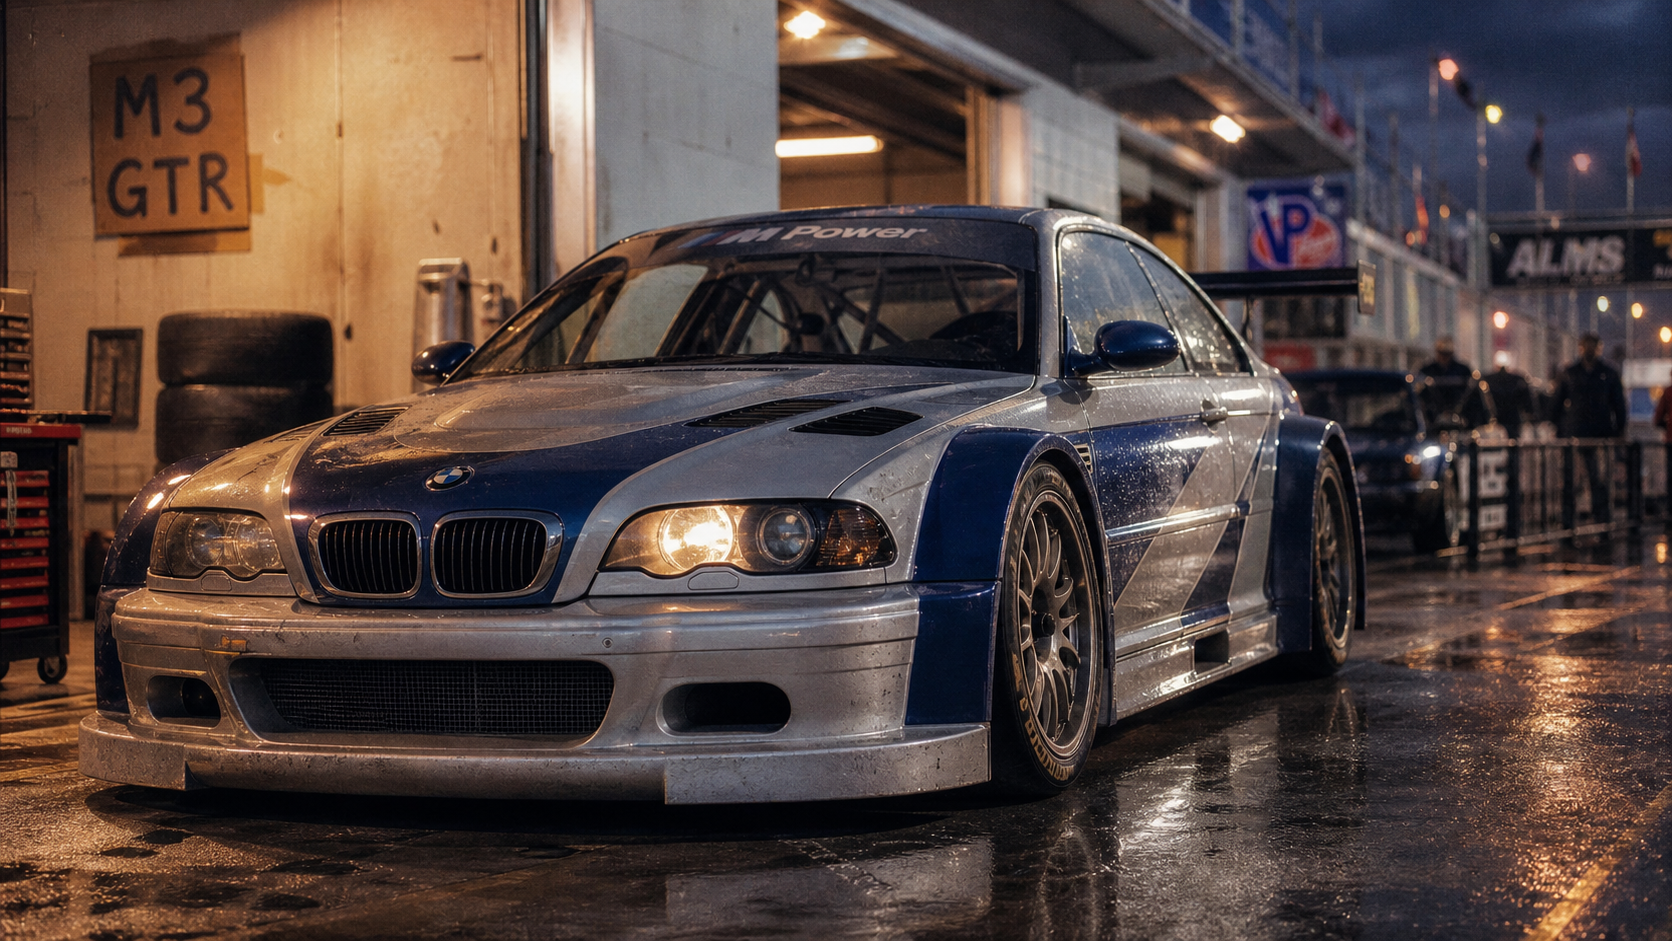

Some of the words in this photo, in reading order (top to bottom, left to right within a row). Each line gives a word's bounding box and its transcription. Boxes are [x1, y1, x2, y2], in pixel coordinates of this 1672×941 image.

[113, 68, 213, 140] M3
[107, 152, 234, 219] GTR
[716, 226, 784, 246] M
[780, 225, 928, 241] Power
[1258, 202, 1311, 265] VP
[1507, 236, 1626, 279] ALMS
